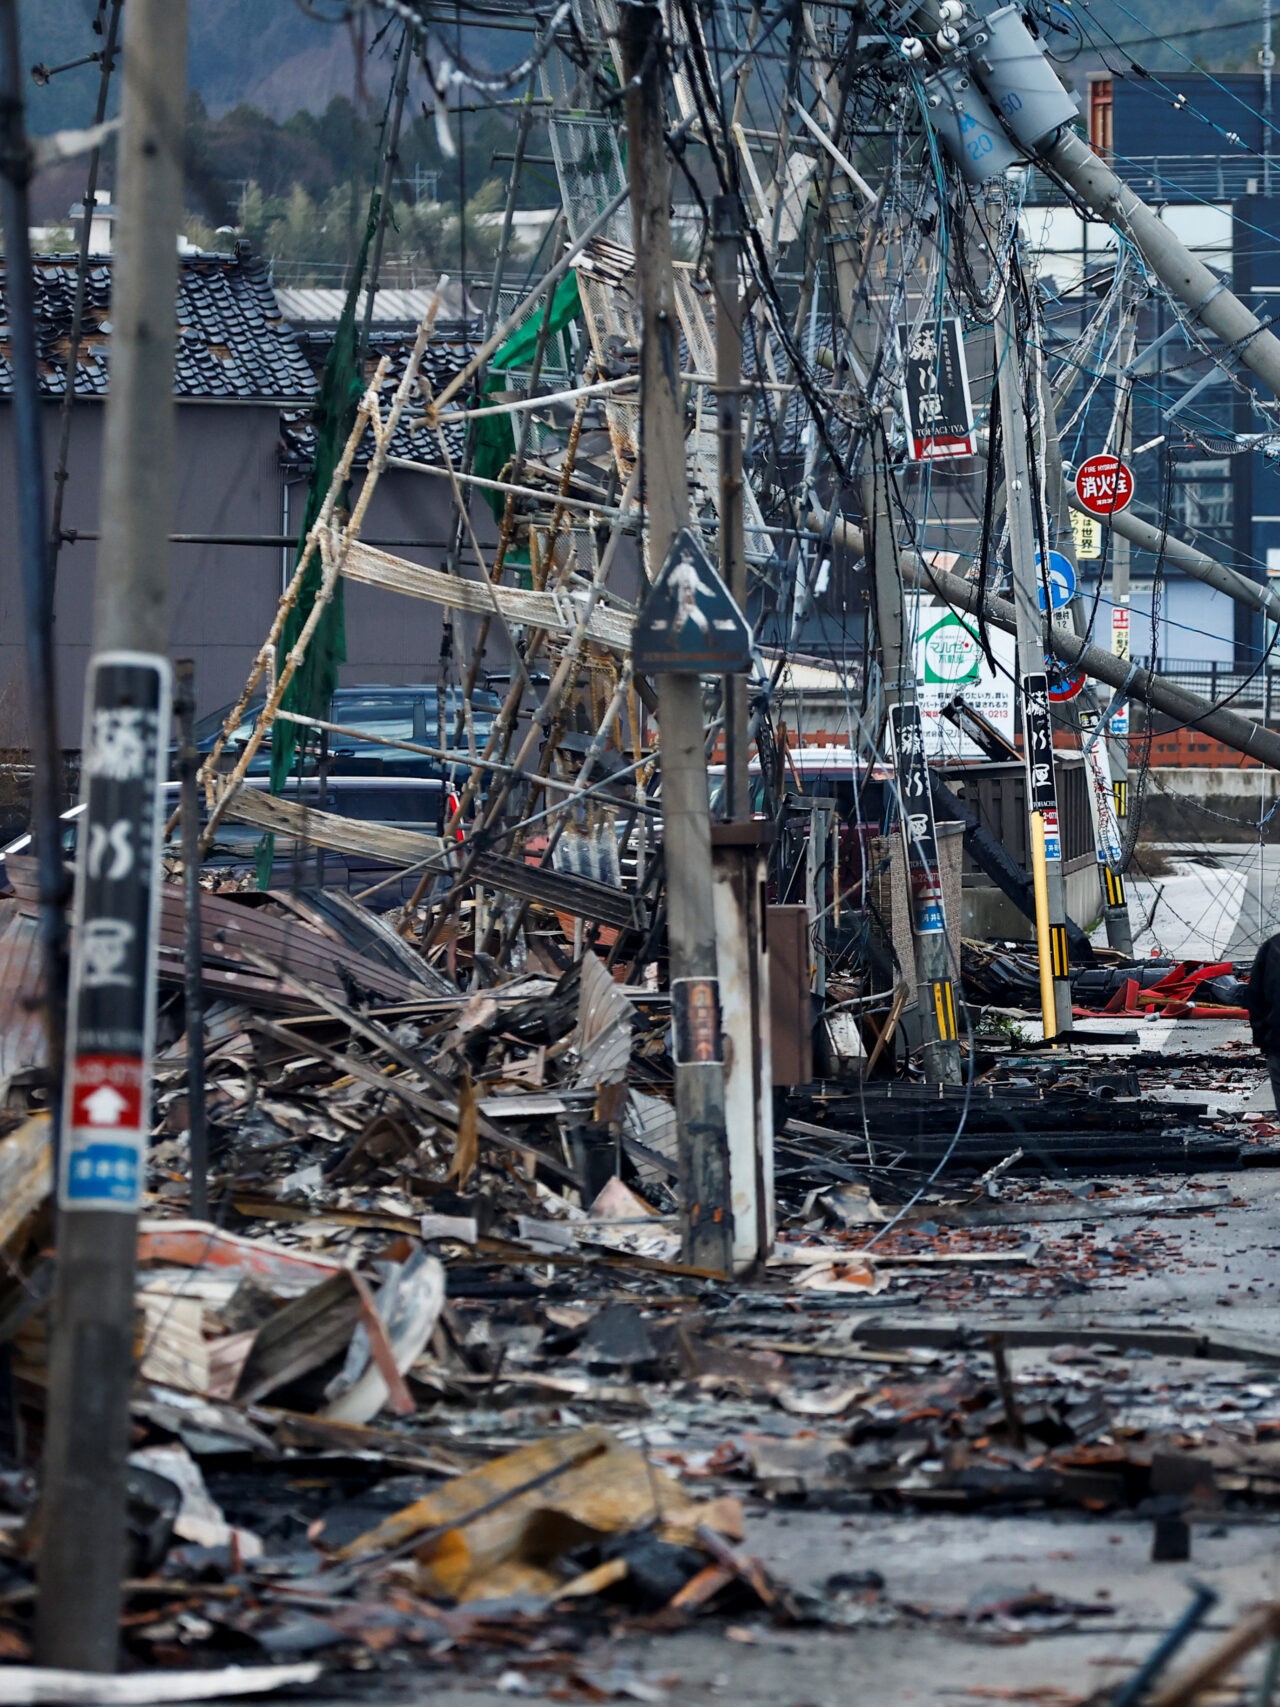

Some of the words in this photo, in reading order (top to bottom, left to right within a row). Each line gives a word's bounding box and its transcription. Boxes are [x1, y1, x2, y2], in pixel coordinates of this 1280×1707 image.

[1001, 92, 1023, 115] 50
[966, 134, 993, 160] 20
[1084, 466, 1097, 474] FIRE
[1081, 472, 1128, 499] 消火栓
